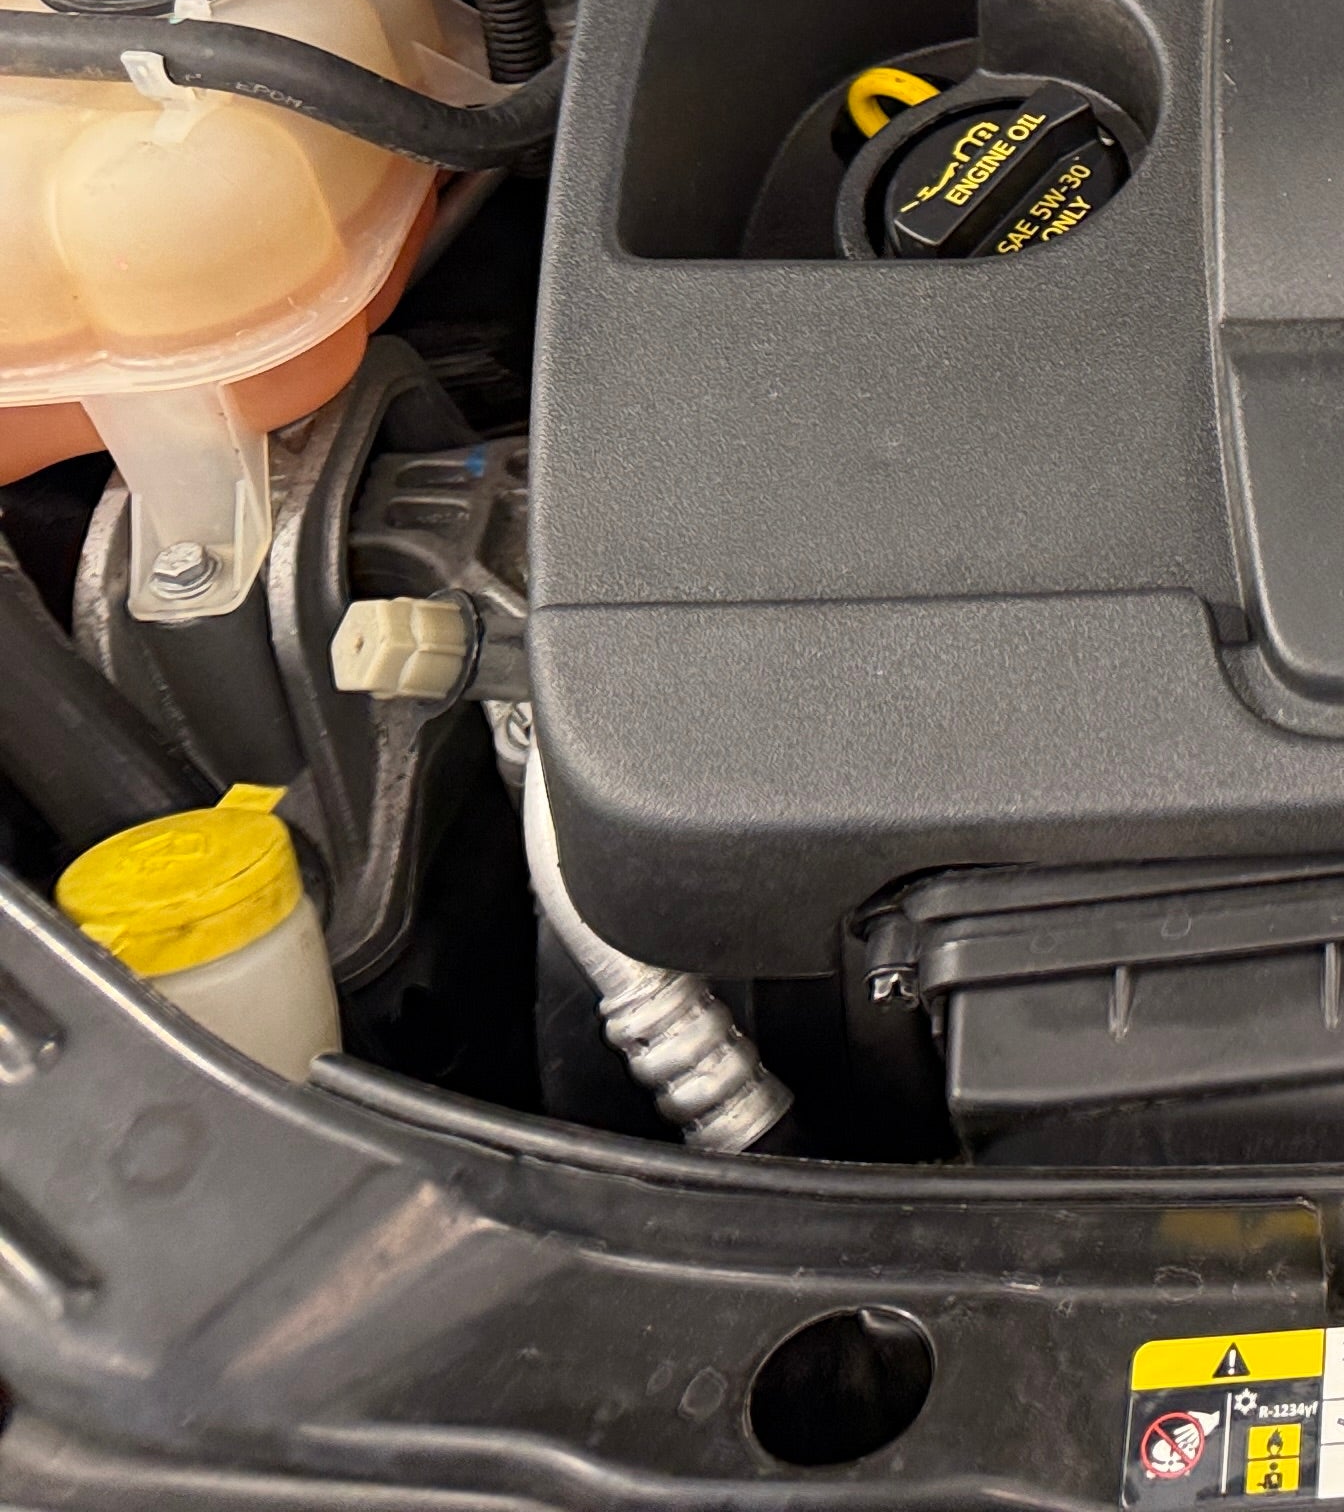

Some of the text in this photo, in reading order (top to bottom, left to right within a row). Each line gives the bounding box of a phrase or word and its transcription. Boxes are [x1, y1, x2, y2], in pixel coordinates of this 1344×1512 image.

[943, 112, 1047, 206] ENGINE OIL
[997, 164, 1092, 254] SAE 5W-30
[1258, 1400, 1319, 1419] R-1234yf
